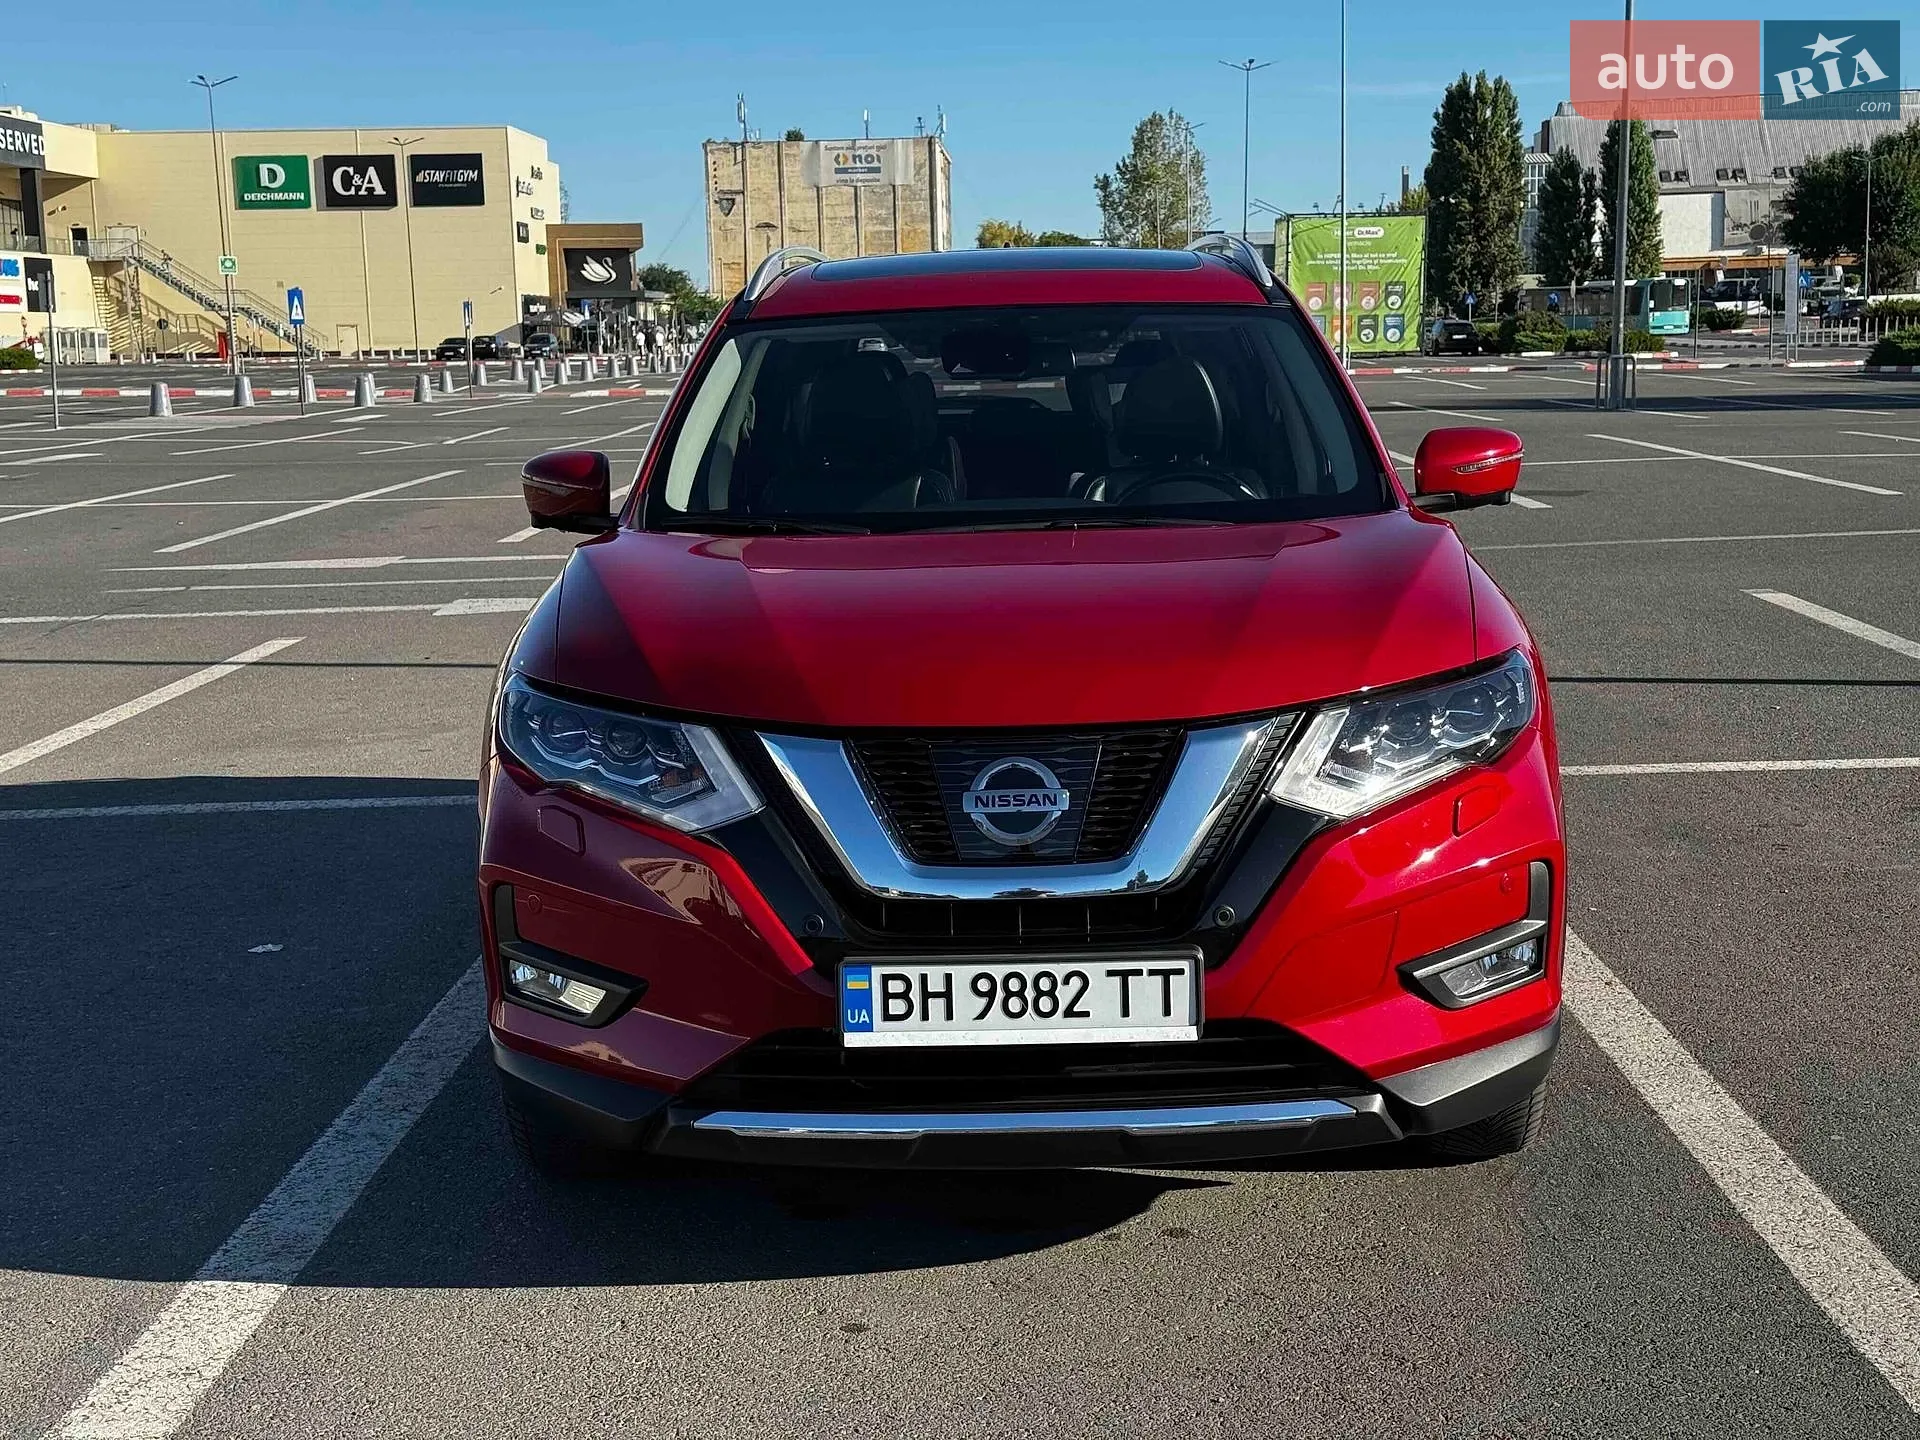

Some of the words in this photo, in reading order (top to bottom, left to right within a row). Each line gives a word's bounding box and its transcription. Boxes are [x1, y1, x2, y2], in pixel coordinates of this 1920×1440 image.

[332, 166, 386, 196] C&A
[244, 192, 305, 201] DEICHMANN
[974, 793, 1058, 808] NISSAN
[880, 972, 954, 1021] BH
[970, 970, 1091, 1021] 9882
[1105, 967, 1186, 1018] TT
[847, 1008, 870, 1024] UA
